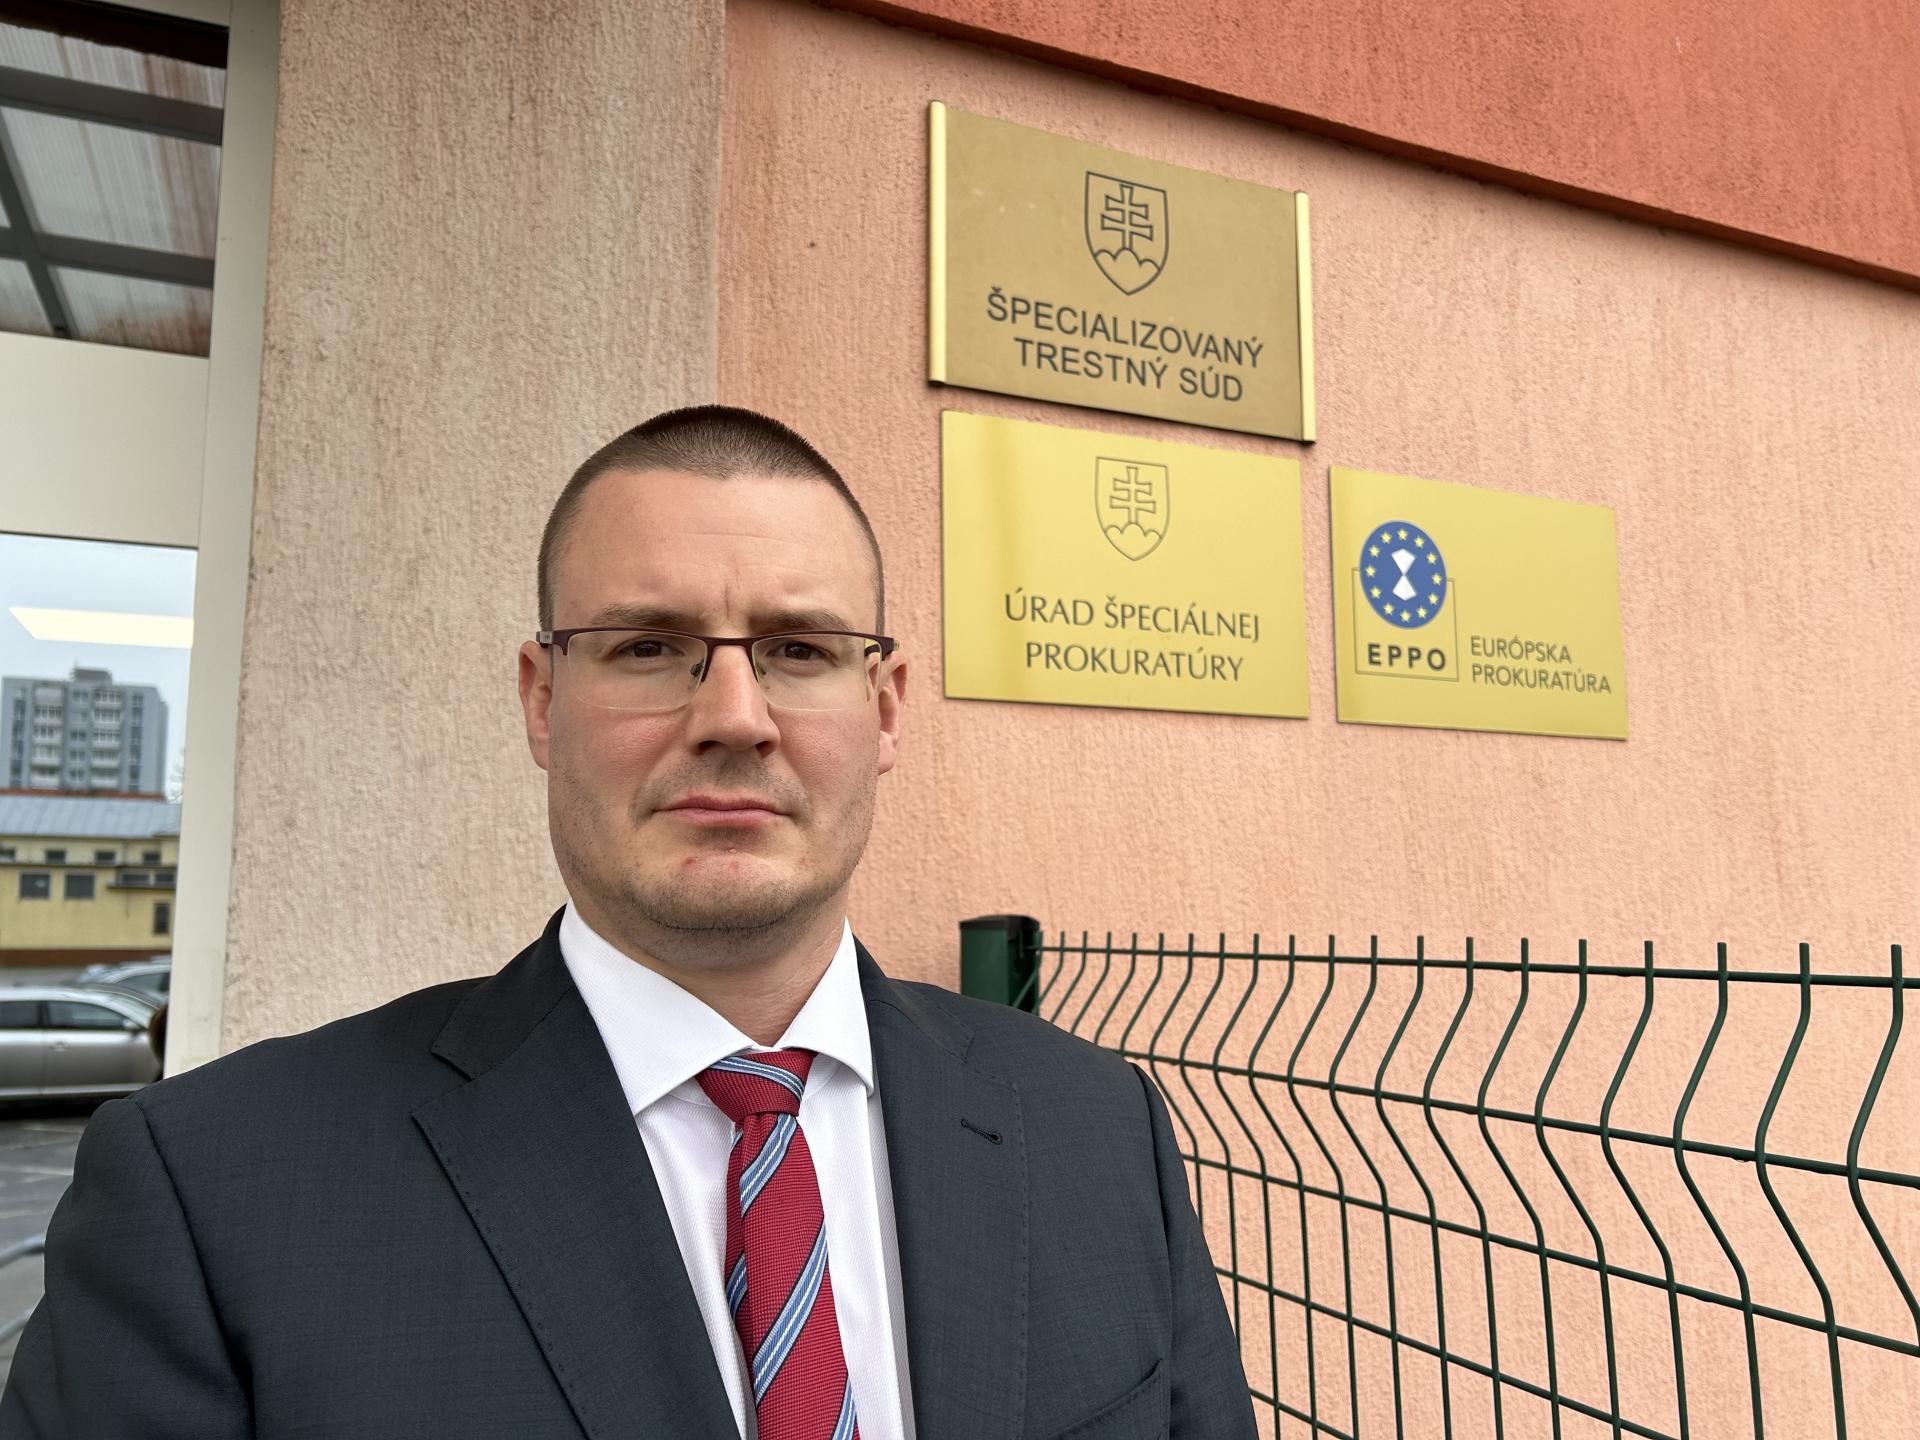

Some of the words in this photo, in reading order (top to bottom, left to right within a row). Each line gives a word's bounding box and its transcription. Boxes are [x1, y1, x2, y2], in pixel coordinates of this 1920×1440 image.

[986, 286, 1264, 368] ŠPECIALIZOVANÝ
[1013, 337, 1168, 389] TRESTNÝ
[1179, 366, 1243, 402] SÚD
[1005, 587, 1094, 626] ÚRAD
[1104, 595, 1260, 643] ŠPECIÁLNEJ
[1026, 642, 1244, 681] PROKURATÚRY
[1367, 643, 1446, 671] EPPO
[1470, 635, 1572, 664] EURÓPSKA
[1472, 664, 1612, 694] PROKURATÚRA
